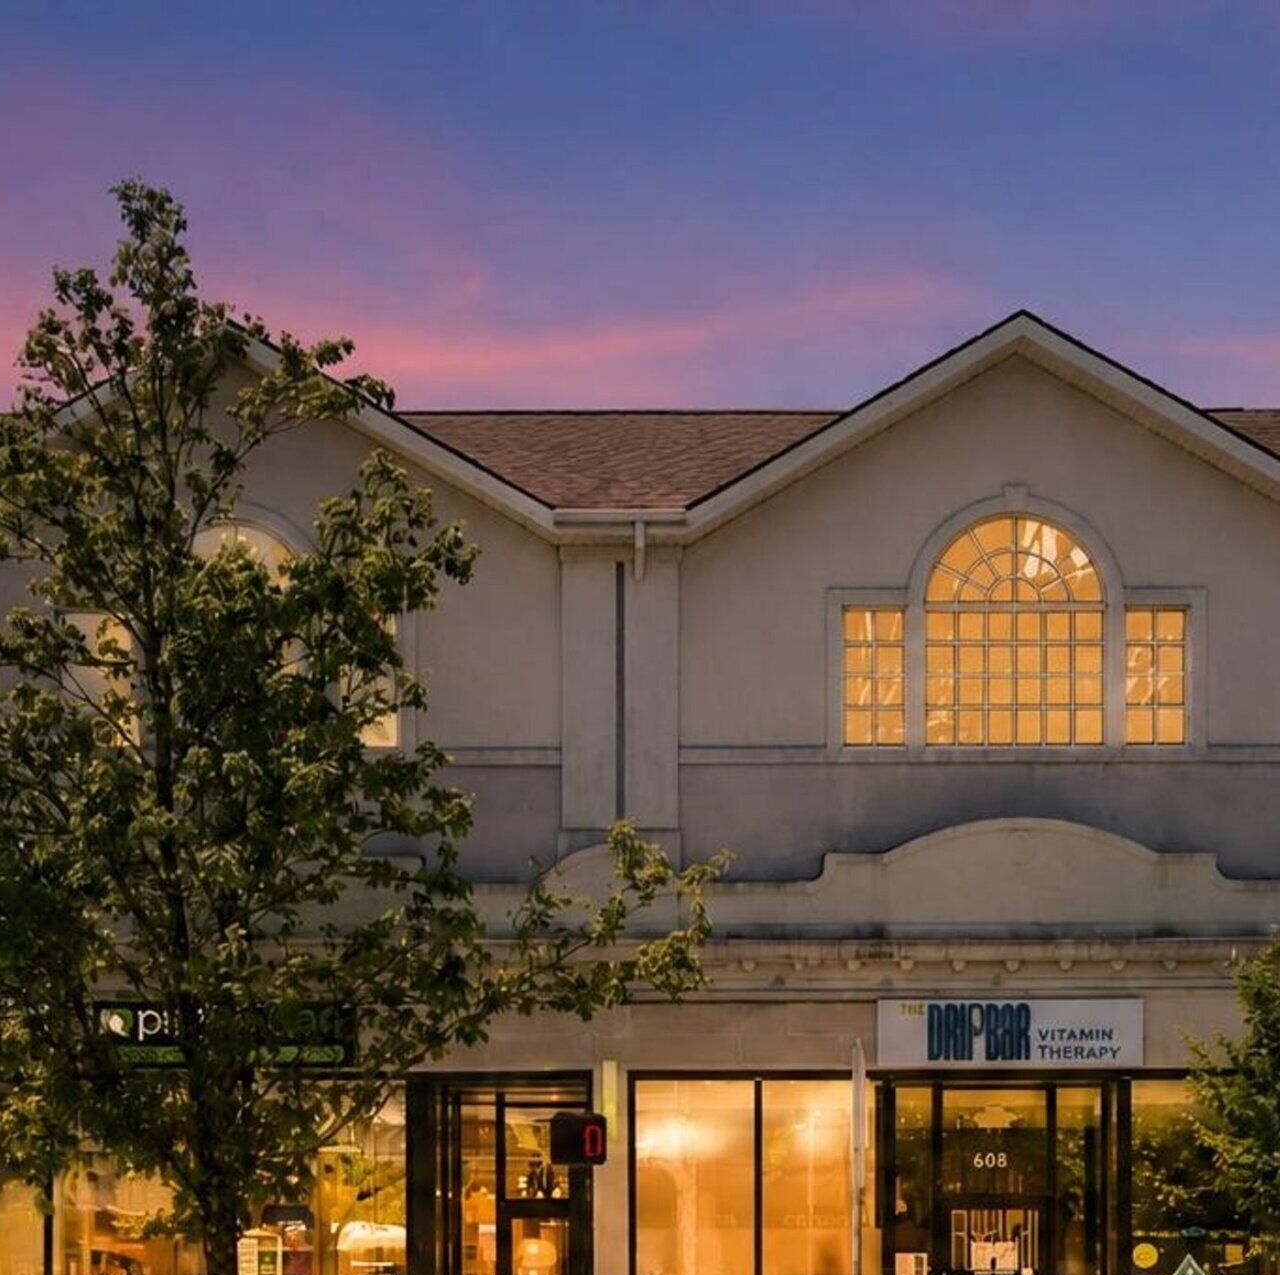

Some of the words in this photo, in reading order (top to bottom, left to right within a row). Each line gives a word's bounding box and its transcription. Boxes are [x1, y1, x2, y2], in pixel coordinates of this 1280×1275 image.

[900, 1003, 926, 1016] THE
[1038, 1028, 1113, 1041] VITAMIN
[1038, 1045, 1120, 1060] THERAPY
[973, 1152, 1008, 1168] 608
